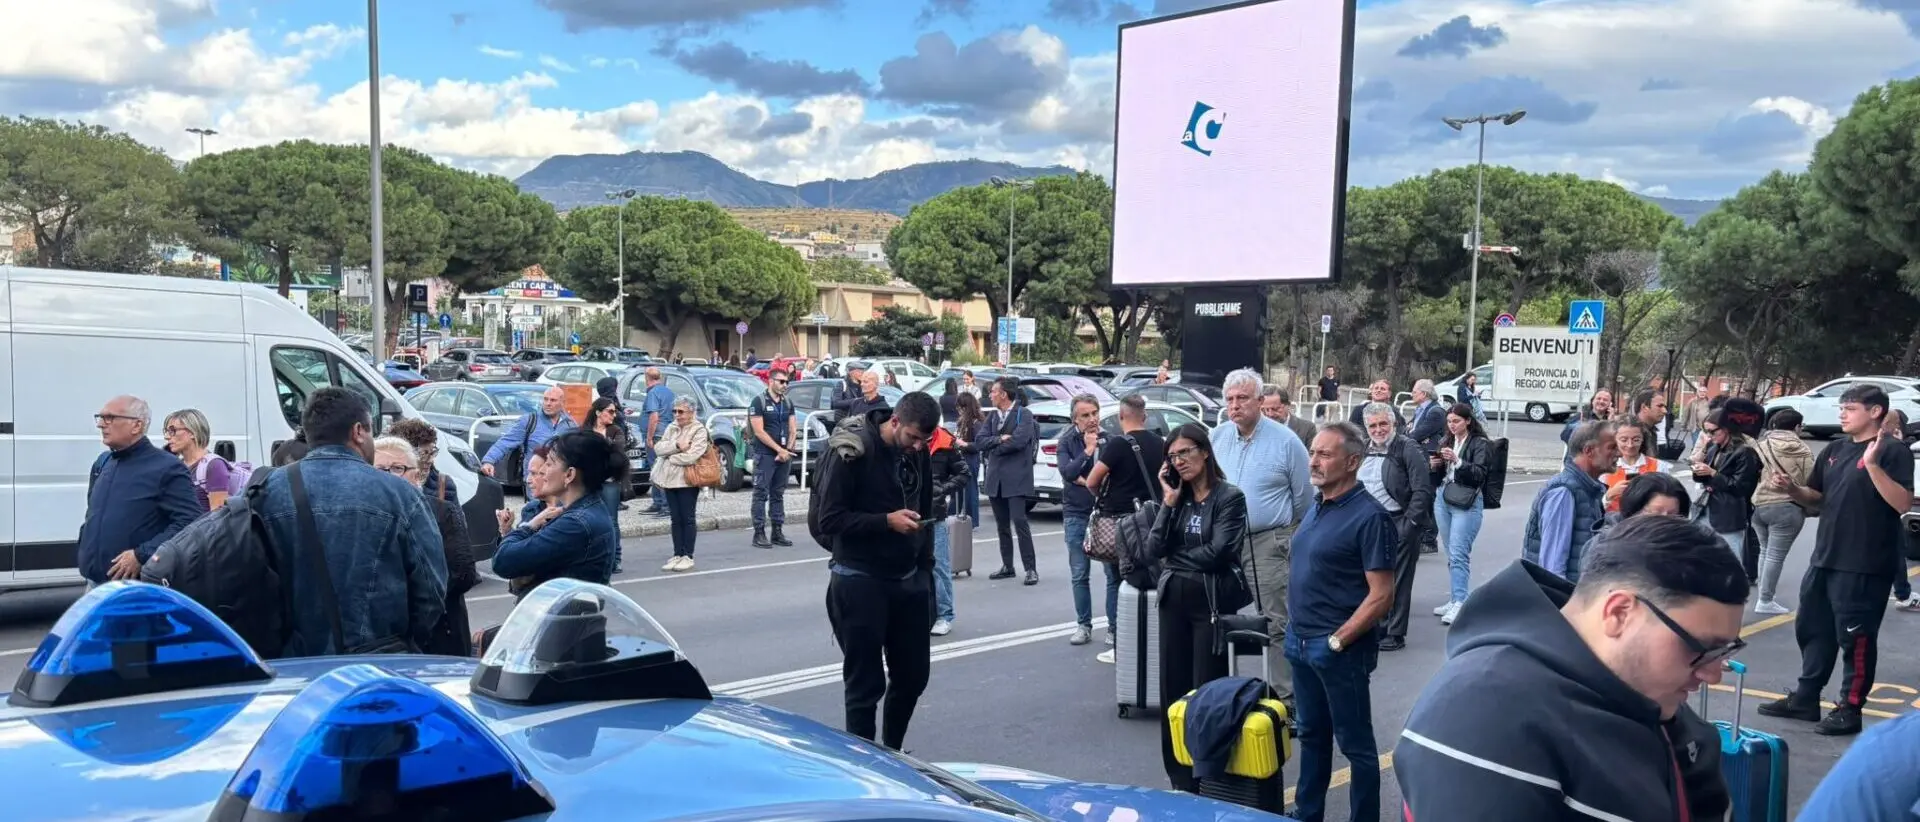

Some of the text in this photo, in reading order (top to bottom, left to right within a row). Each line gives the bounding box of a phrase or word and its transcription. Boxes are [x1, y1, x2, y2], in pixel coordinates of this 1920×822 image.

[529, 282, 546, 290] CAR
[416, 288, 425, 300] P
[1194, 302, 1242, 314] PUBBLIEMME
[1524, 367, 1580, 379] PROVINCIA DI
[1515, 378, 1591, 391] REGGIO CALABA
